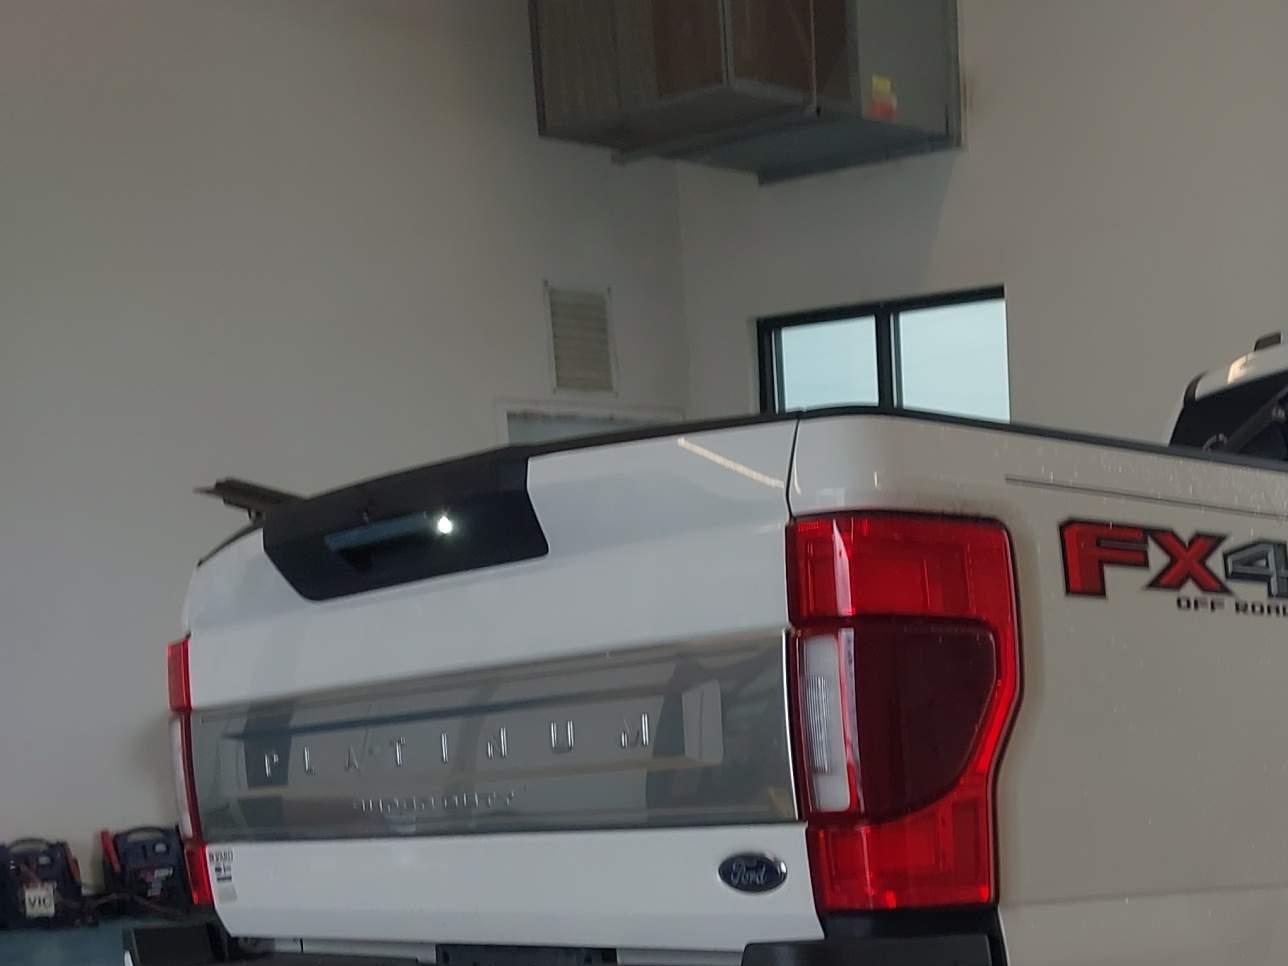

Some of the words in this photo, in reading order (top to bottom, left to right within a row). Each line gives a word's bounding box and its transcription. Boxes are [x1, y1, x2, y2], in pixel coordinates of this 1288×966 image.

[1177, 597, 1224, 612] OFF
[264, 712, 650, 777] PLATINUM
[730, 860, 769, 886] Ford
